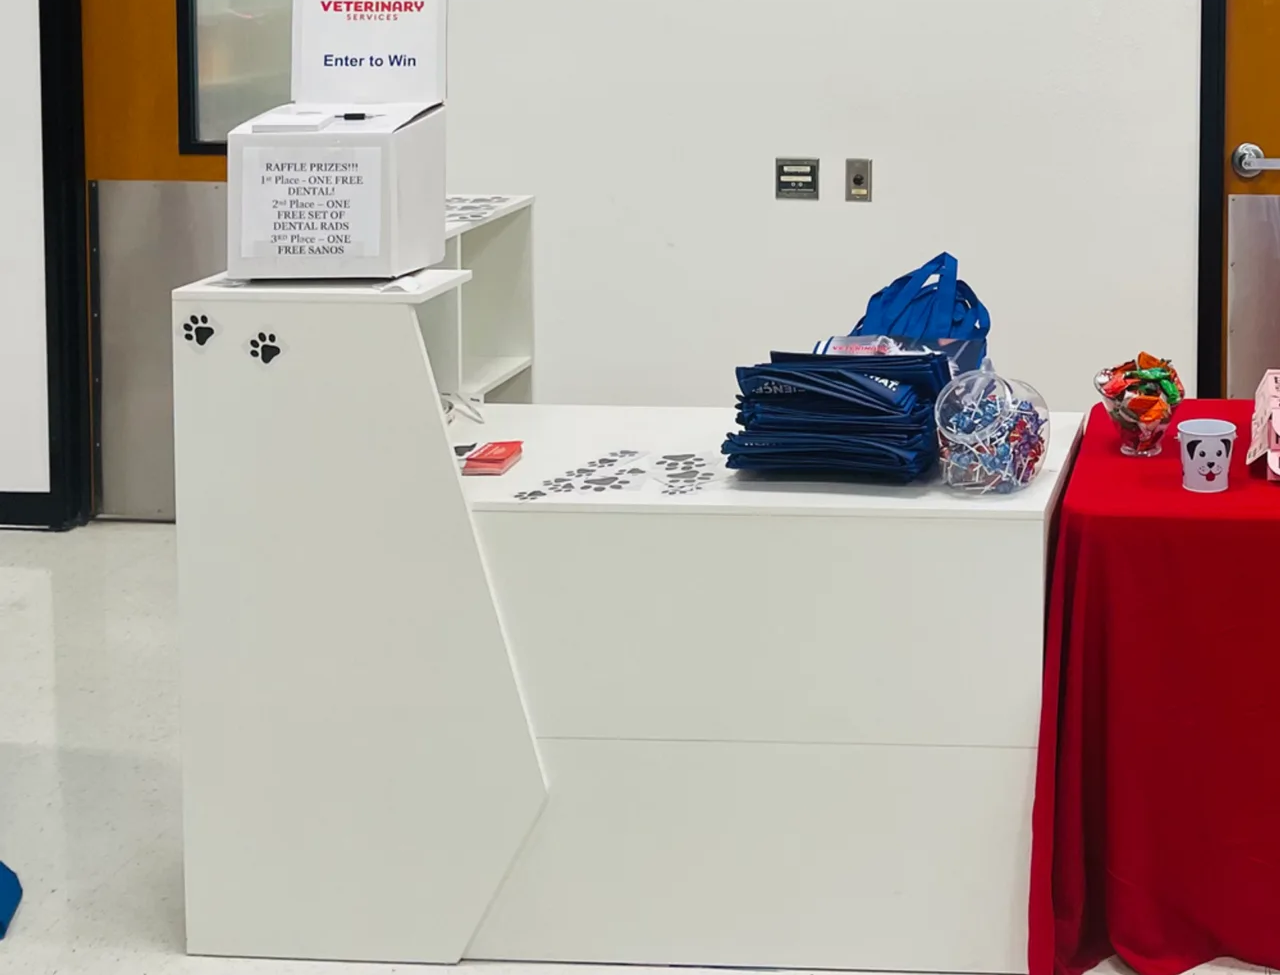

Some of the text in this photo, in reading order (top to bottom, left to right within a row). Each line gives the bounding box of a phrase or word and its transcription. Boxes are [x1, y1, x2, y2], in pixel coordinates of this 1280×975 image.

[320, 1, 425, 12] VETERINARY
[323, 54, 416, 67] Enter to Win
[265, 162, 359, 172] RAFFLE PRIZES!!!
[275, 175, 300, 185] Place
[308, 175, 333, 185] ONE
[335, 175, 364, 185] FREE
[288, 186, 336, 196] DENTAL!
[289, 199, 315, 209] Place
[326, 199, 351, 209] ONE
[277, 210, 346, 220] FREE SET OF
[273, 221, 350, 231] DENTAL RADS
[290, 233, 316, 244] Place
[327, 234, 352, 244] ONE
[277, 245, 345, 255] FREE SANOS
